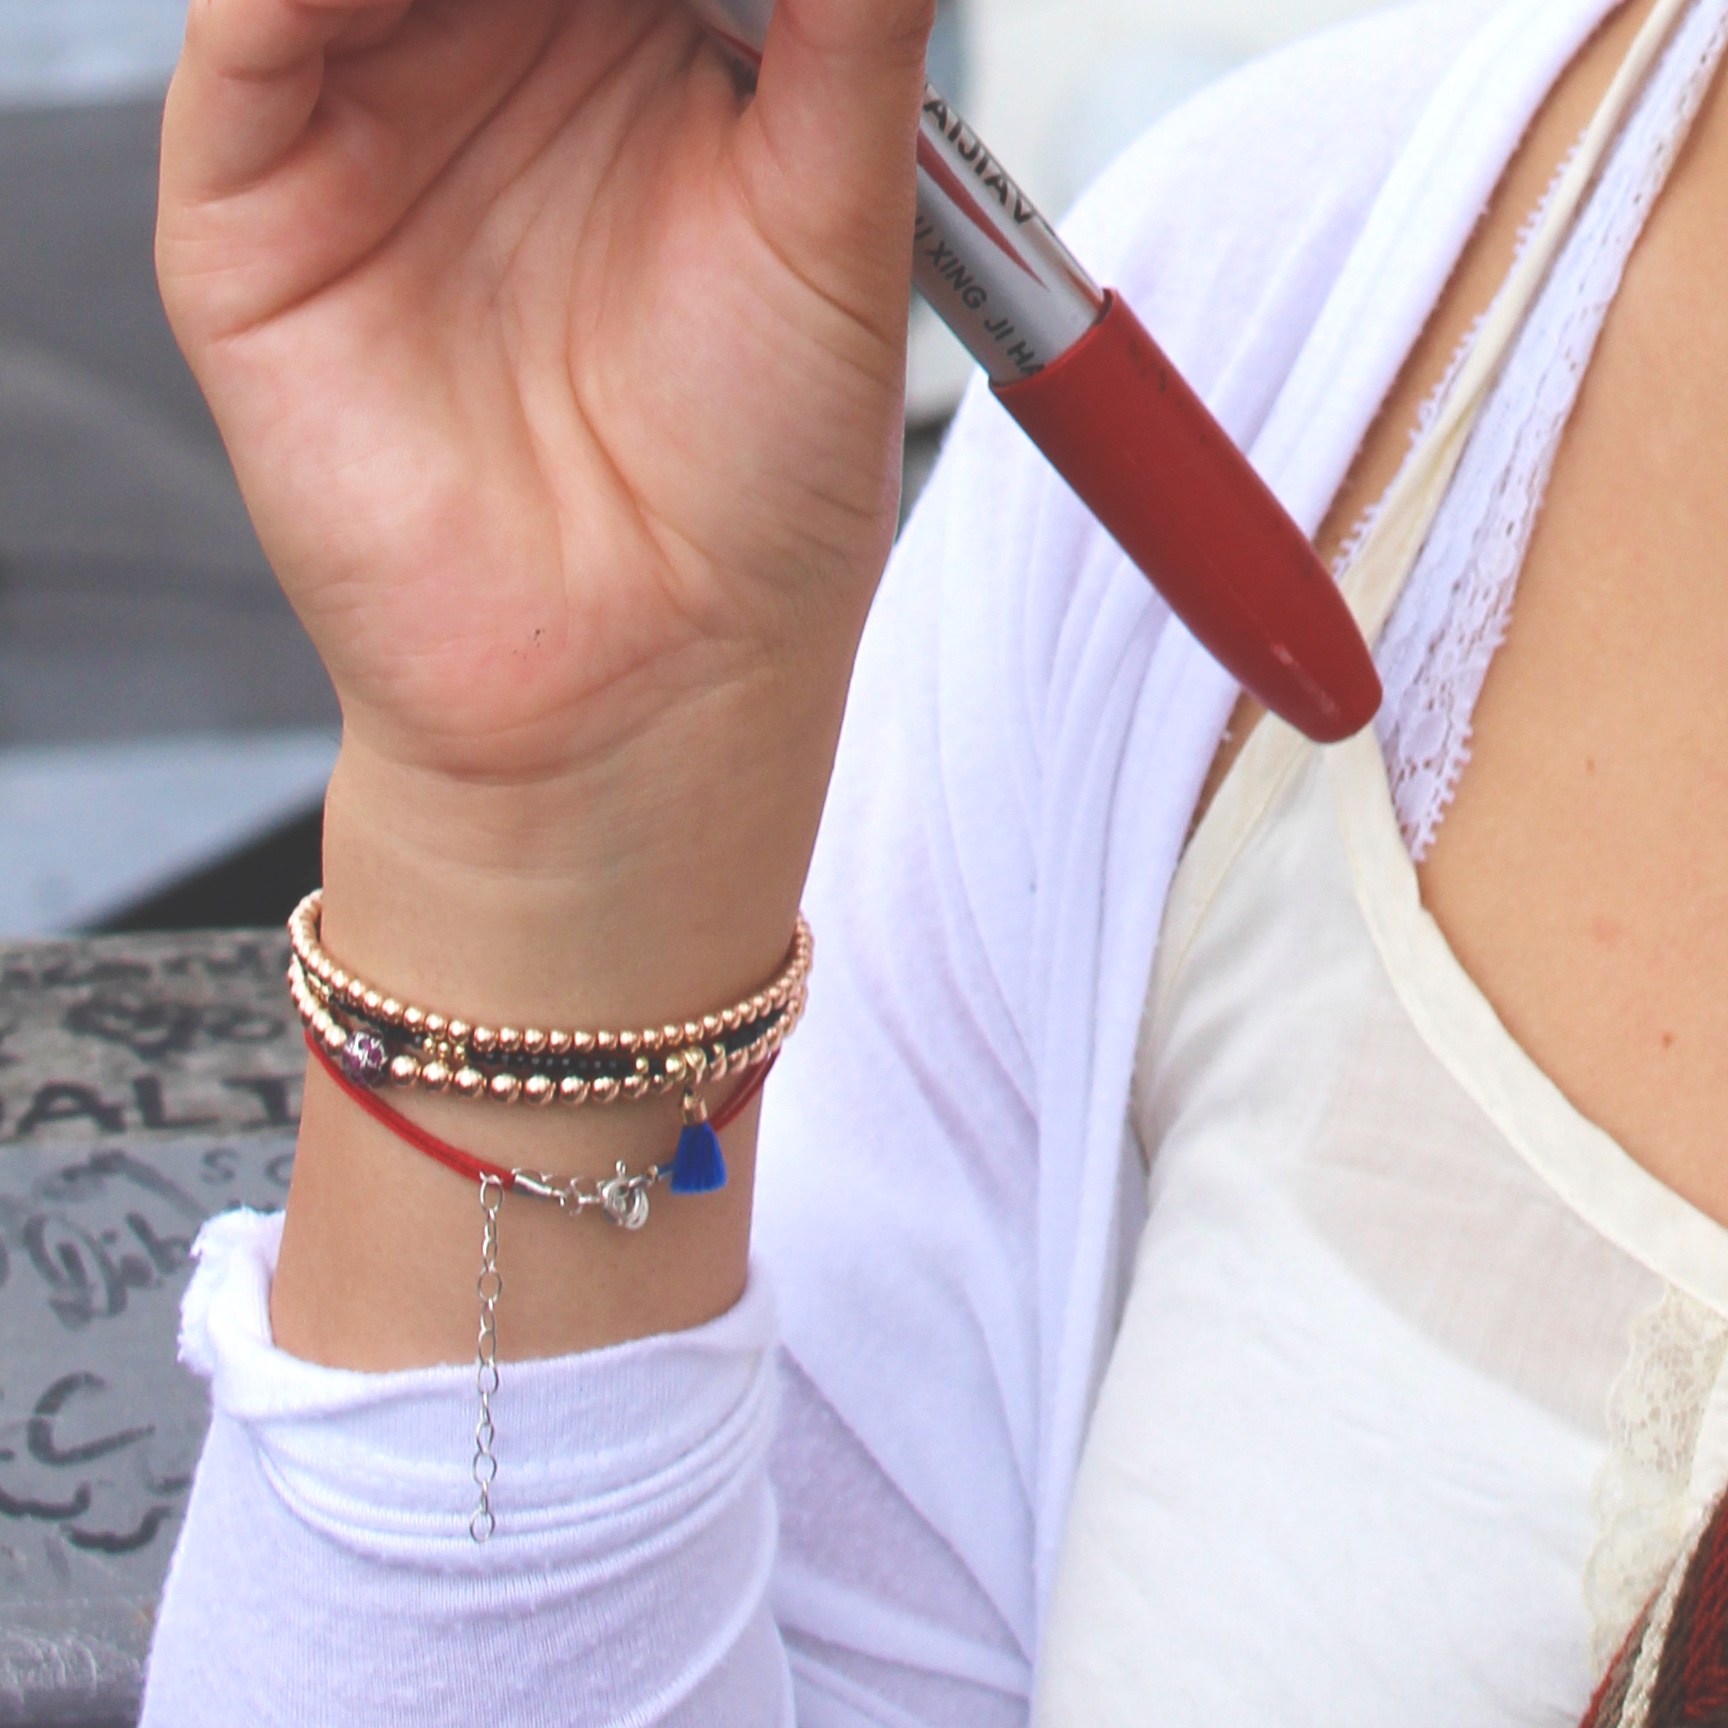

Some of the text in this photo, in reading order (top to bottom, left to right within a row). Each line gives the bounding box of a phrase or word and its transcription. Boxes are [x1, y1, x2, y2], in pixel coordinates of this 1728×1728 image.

[924, 82, 1033, 225] AIJIAV
[925, 240, 989, 311] XING
[984, 318, 1015, 342] JI
